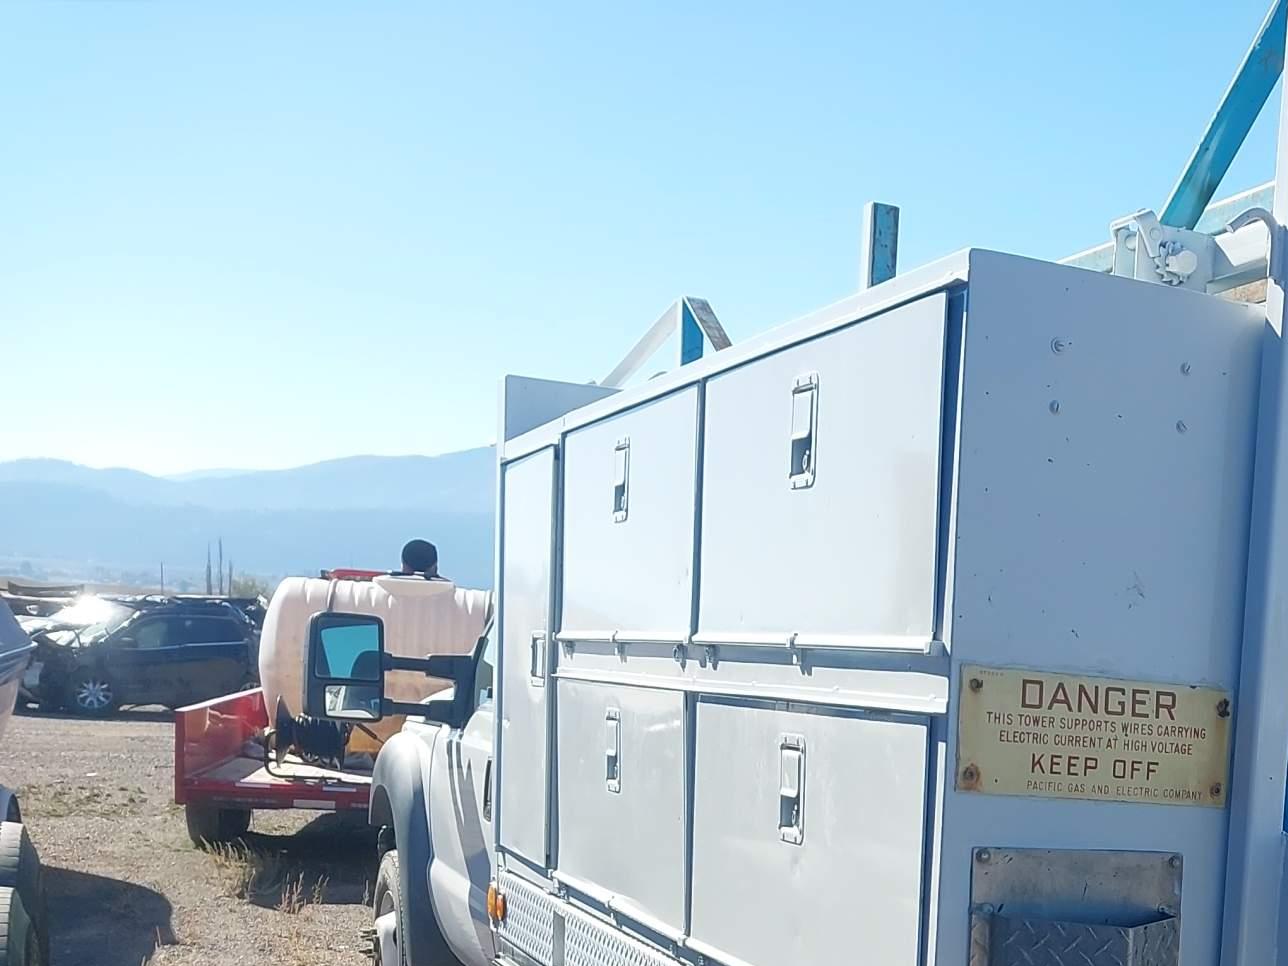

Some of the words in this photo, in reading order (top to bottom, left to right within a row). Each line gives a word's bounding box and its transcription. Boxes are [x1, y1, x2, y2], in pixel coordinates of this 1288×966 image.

[1021, 679, 1177, 720] DANGER
[987, 712, 1013, 724] THIS
[1017, 714, 1055, 728] TOWER
[1059, 717, 1116, 732] SUPPORTS
[1122, 722, 1153, 736] WIRES
[1157, 725, 1206, 739] CARRYING
[1000, 730, 1049, 744] ELECTRIC
[1054, 735, 1102, 748] CURRENT
[1106, 736, 1119, 750] AT
[1123, 740, 1148, 751] HIGH
[1151, 741, 1192, 755] VOLTAGE
[1031, 753, 1098, 776] KEEP
[1113, 759, 1159, 780] OFF
[1027, 781, 1063, 792] PACIFIC
[1068, 783, 1085, 793] GAS
[1091, 784, 1110, 794] AND
[1116, 785, 1159, 797] ELECTRIC
[1163, 788, 1202, 800] COMPANY
